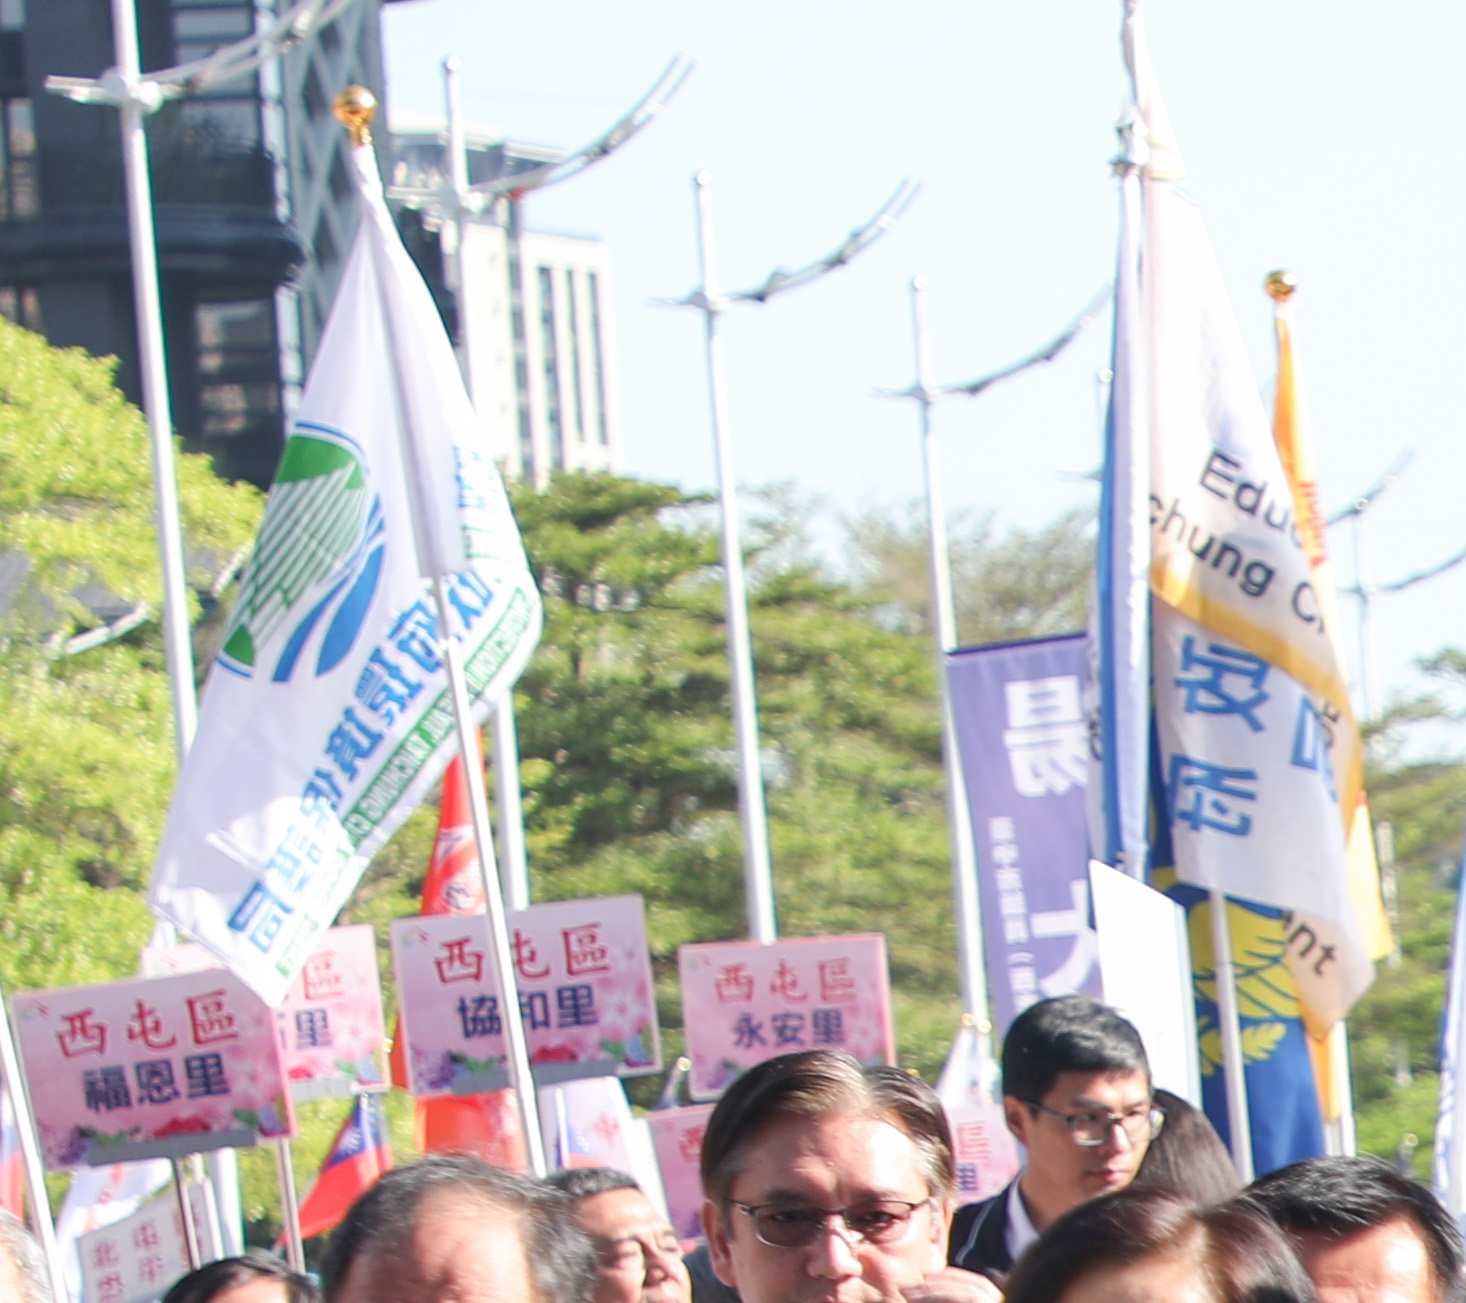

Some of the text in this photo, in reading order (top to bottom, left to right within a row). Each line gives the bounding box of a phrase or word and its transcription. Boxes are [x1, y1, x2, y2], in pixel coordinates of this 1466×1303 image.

[714, 956, 858, 1005] 西屯區
[57, 990, 239, 1059] 西屯區
[733, 1008, 845, 1050] 永安里
[83, 1053, 231, 1113] 福恩里
